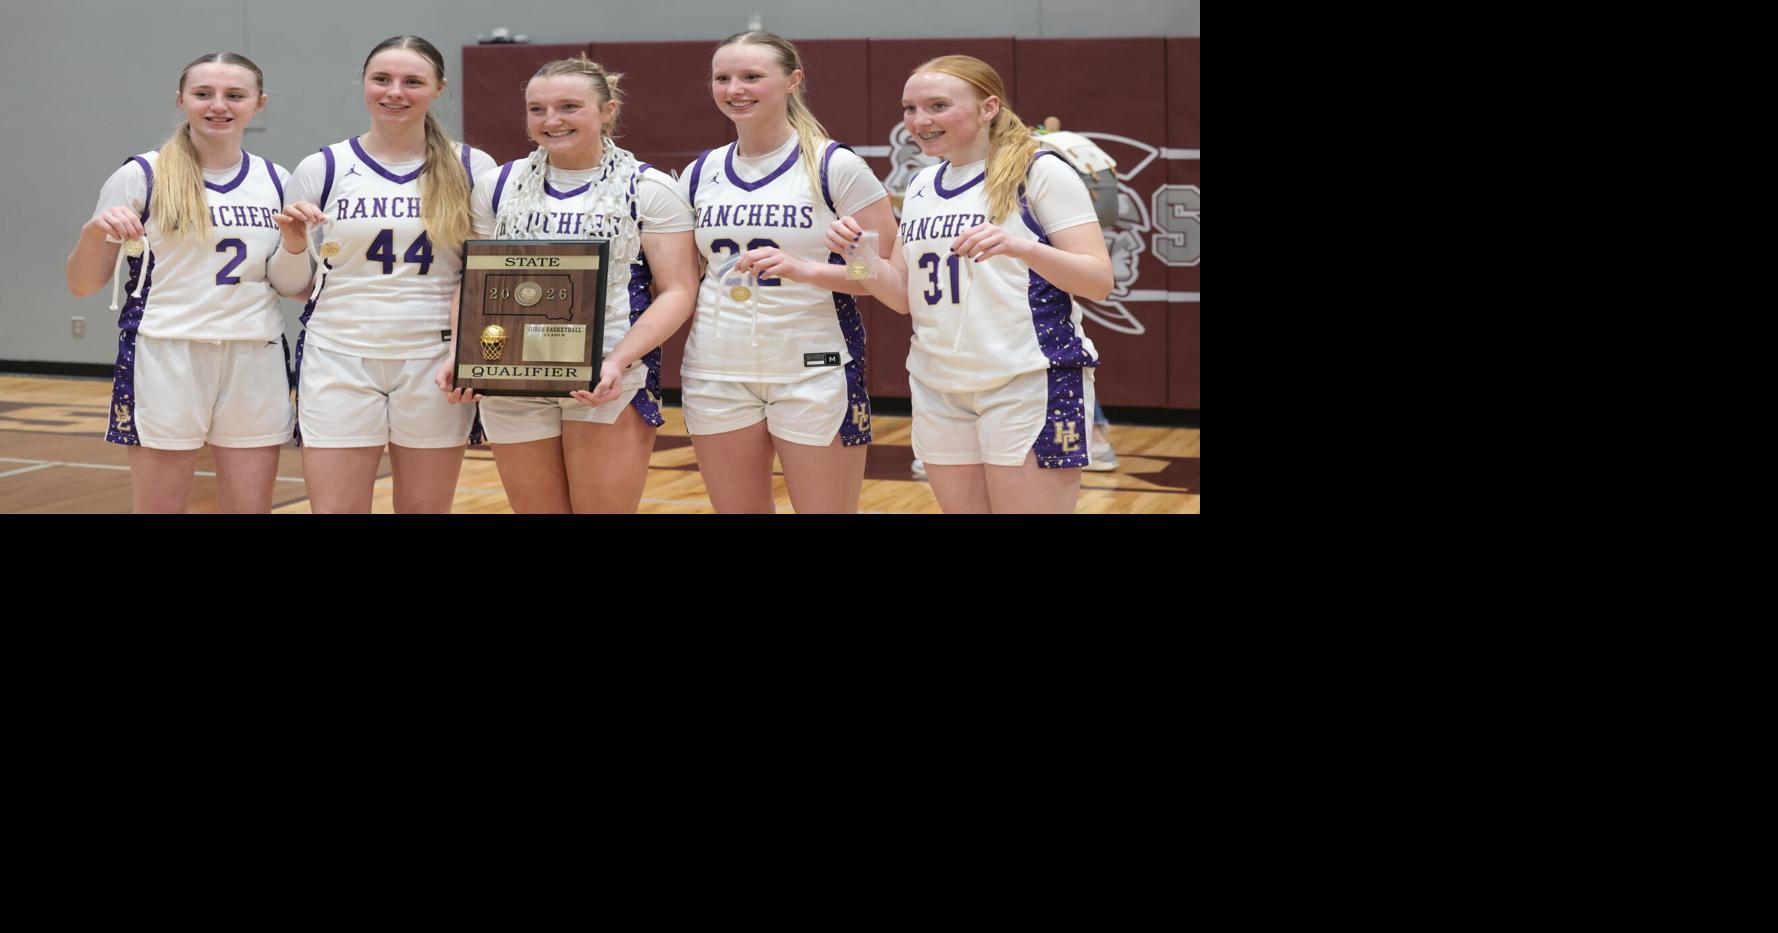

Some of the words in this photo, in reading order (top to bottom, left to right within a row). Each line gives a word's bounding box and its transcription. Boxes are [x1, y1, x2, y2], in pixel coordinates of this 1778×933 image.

[336, 196, 421, 221] RANCH
[215, 238, 248, 286] 2
[366, 228, 434, 276] 44
[504, 257, 561, 267] STATE
[918, 252, 960, 306] 31
[489, 287, 511, 300] 20
[546, 288, 568, 300] 26
[546, 326, 582, 334] BASKETBALL
[471, 366, 578, 378] QUALIFIER
[1053, 420, 1080, 452] HC
